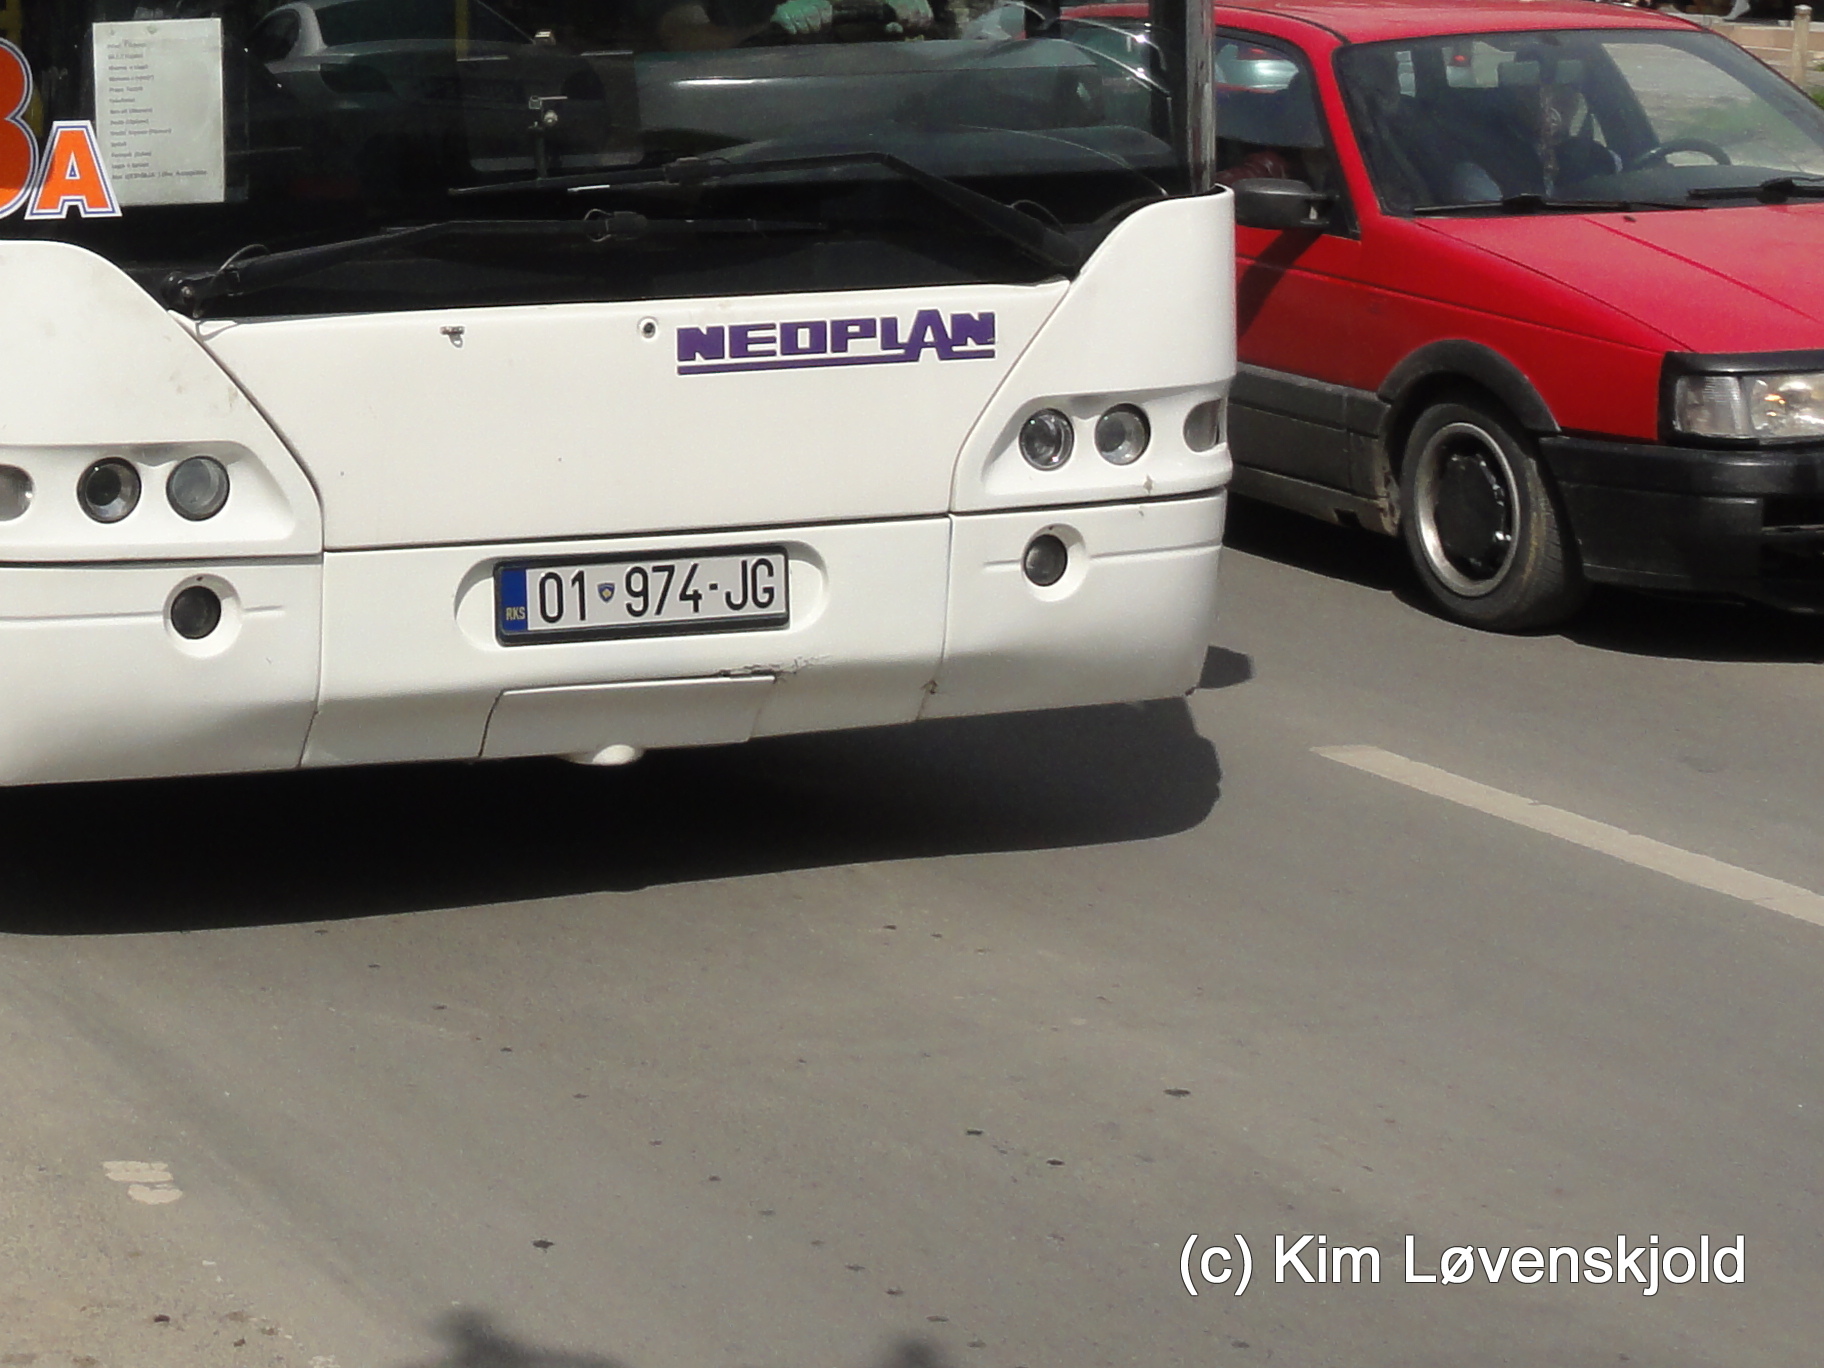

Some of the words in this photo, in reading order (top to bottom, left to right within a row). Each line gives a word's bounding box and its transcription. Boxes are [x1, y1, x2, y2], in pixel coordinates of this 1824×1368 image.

[676, 308, 997, 364] NEOPLAN
[506, 606, 526, 621] RKS
[537, 569, 587, 624] 01
[624, 557, 776, 618] 974-JG
